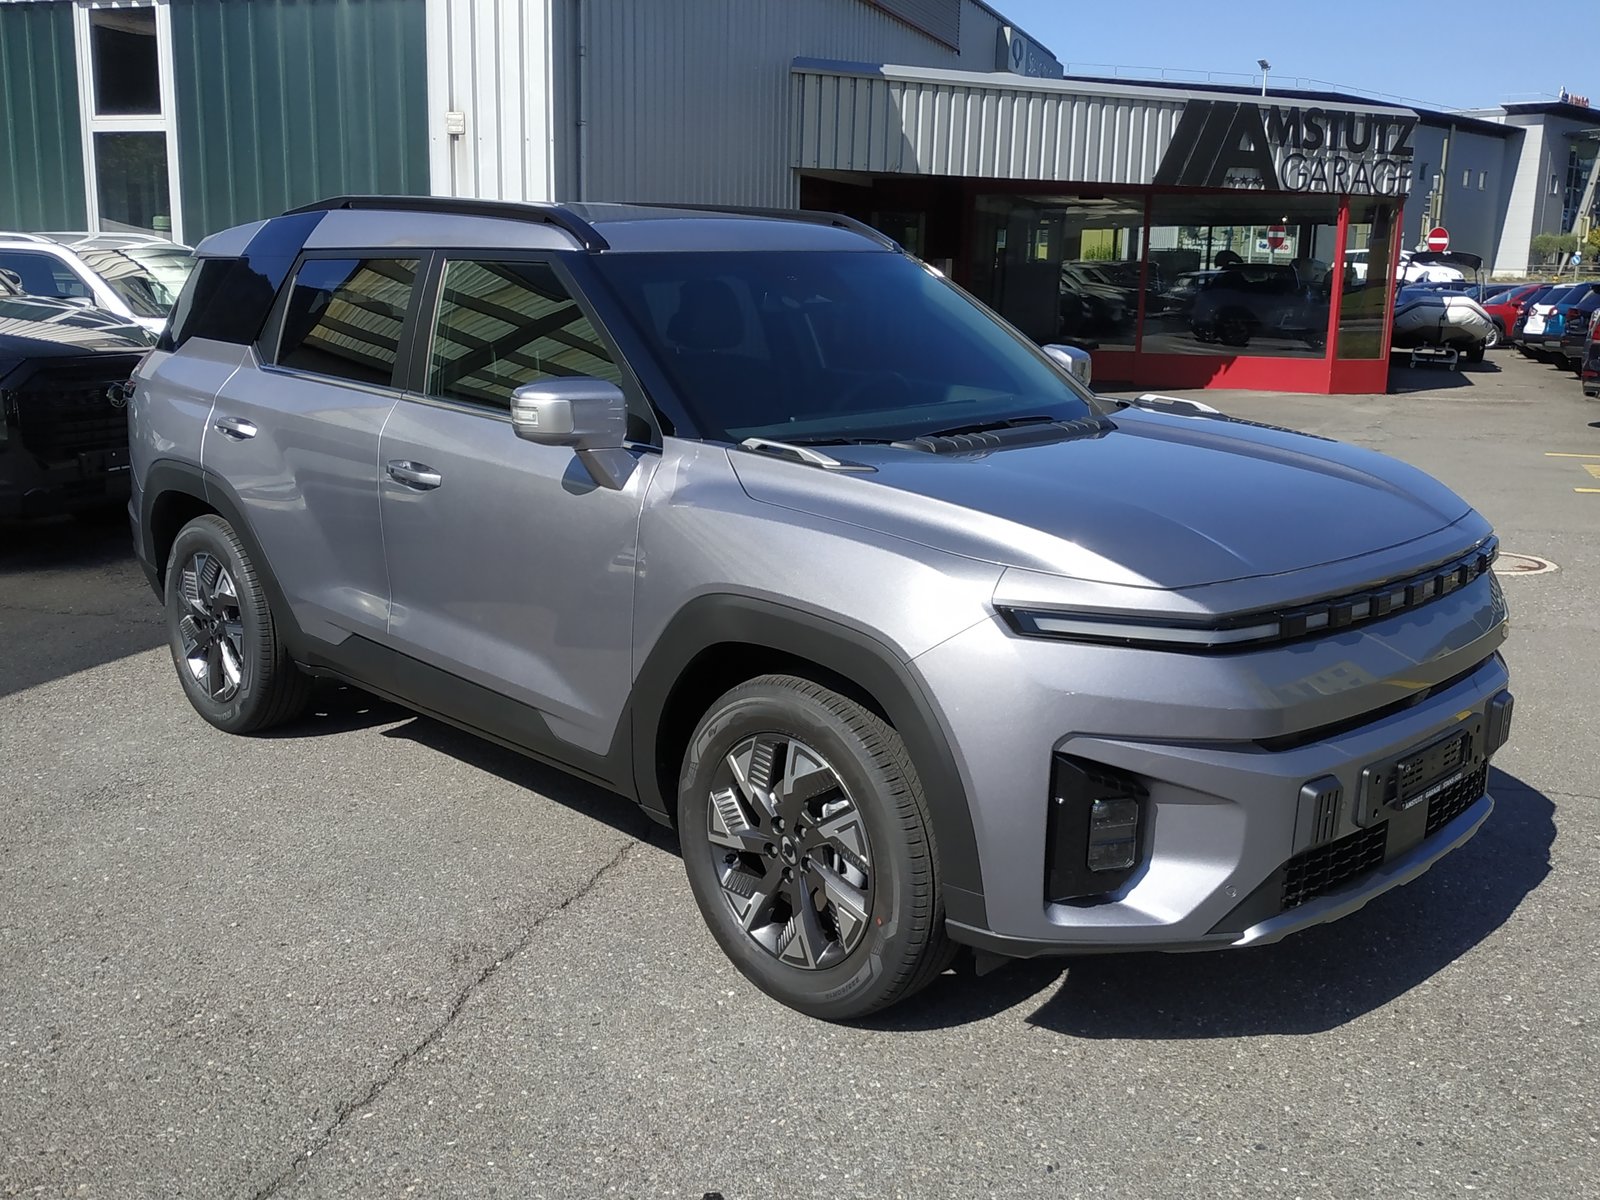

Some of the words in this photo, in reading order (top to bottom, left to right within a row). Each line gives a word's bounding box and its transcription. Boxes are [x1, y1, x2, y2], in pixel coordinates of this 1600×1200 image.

[1204, 101, 1421, 191] AMSTUTZ
[1281, 152, 1413, 198] GARAGE
[1405, 795, 1424, 810] AMSTUTZ
[1425, 784, 1441, 799] GARAGE
